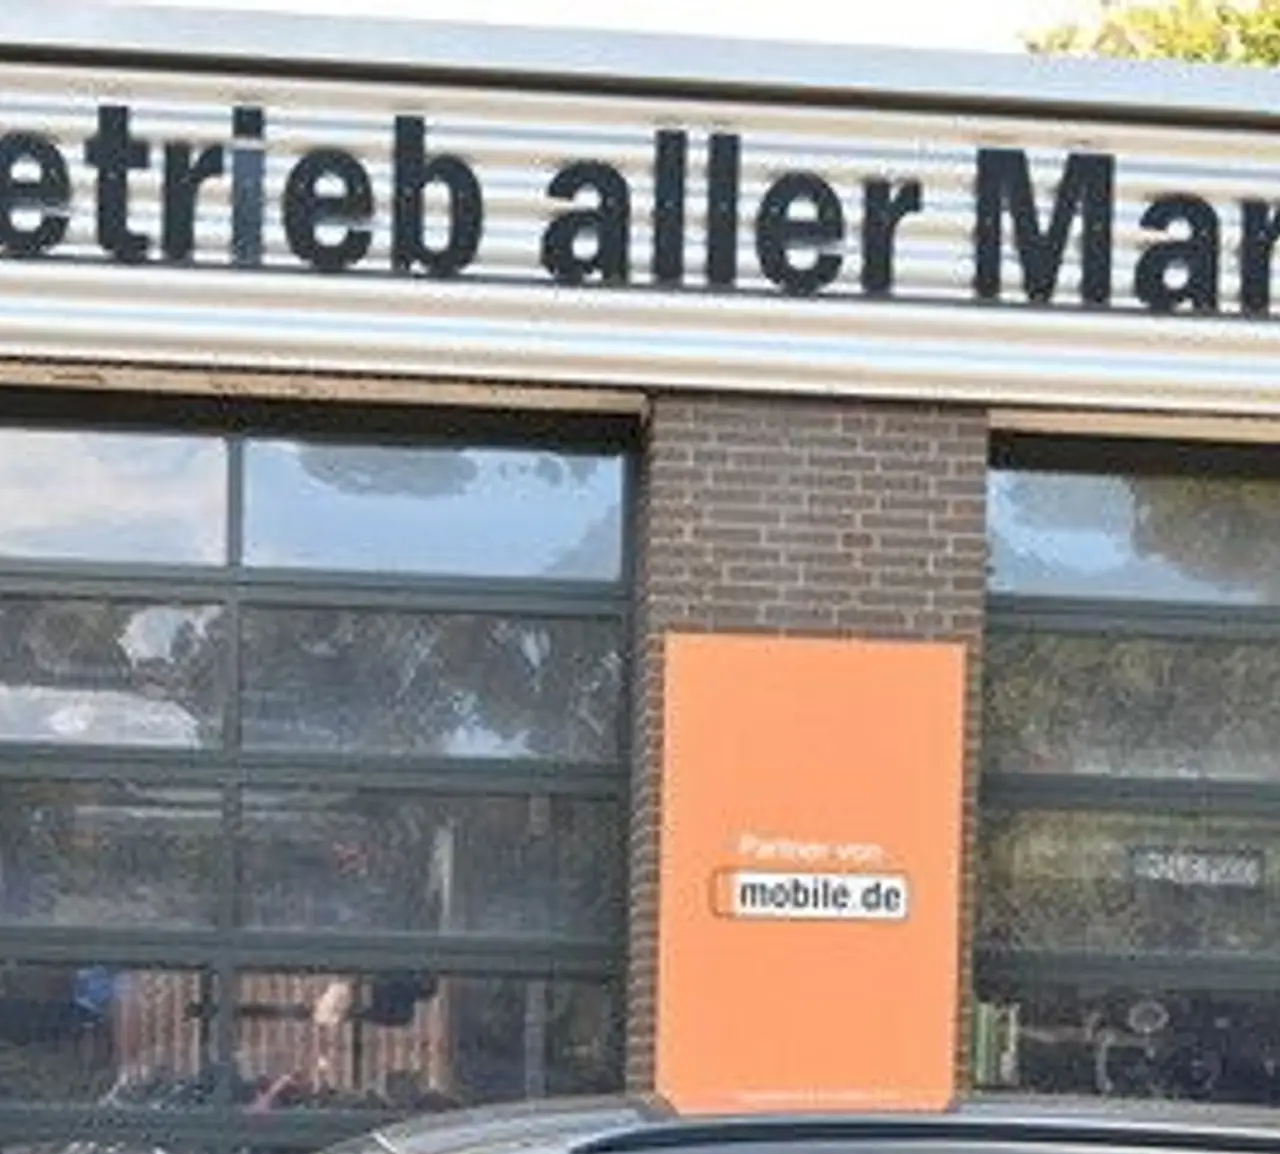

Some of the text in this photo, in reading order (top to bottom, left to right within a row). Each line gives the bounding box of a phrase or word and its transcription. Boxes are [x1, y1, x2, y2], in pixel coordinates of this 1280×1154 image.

[537, 126, 924, 298] aller
[740, 832, 828, 865] Partner
[739, 875, 902, 913] mobile.de
